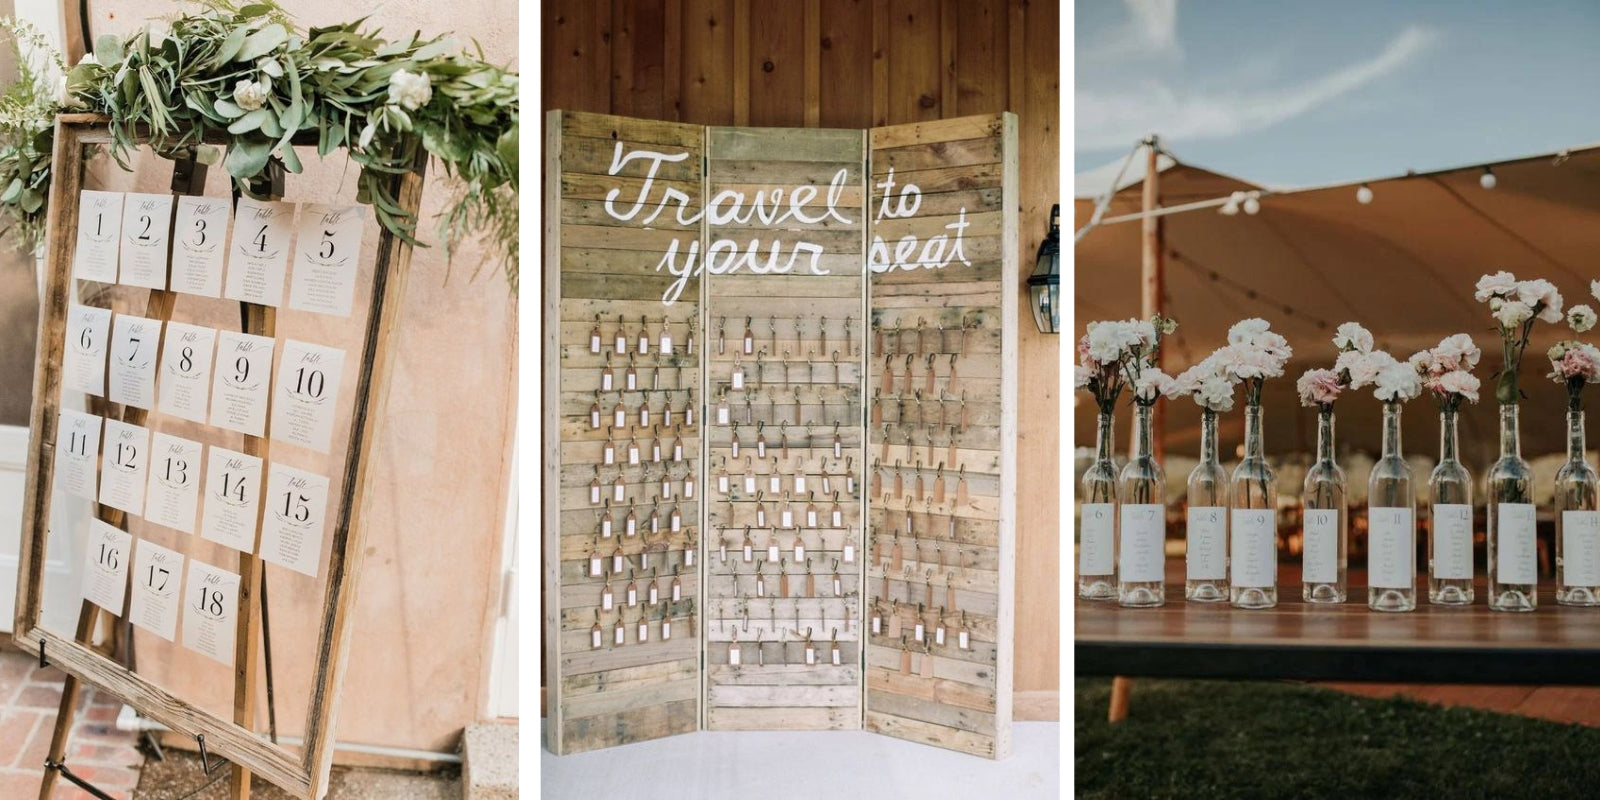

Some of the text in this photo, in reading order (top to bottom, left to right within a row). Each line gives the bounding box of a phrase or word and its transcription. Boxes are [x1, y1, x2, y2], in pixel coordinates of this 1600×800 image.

[604, 141, 922, 227] Travel to
[96, 213, 103, 237] 1
[138, 215, 151, 240] 2
[192, 219, 207, 247] 3
[252, 225, 268, 252] 4
[318, 230, 336, 259] 5
[656, 206, 972, 307] your seat
[80, 327, 92, 350] 6
[128, 338, 141, 362] 7
[179, 346, 194, 373] 8
[234, 356, 250, 383] 9
[295, 366, 325, 399] 10
[69, 432, 87, 457] 11
[115, 442, 137, 470] 12
[164, 457, 188, 485] 13
[221, 472, 246, 502] 14
[282, 491, 310, 523] 15
[1095, 510, 1103, 519] 6
[1148, 510, 1156, 521] 7
[1209, 511, 1218, 523] 8
[1256, 514, 1265, 526] 9
[1316, 514, 1328, 526] 10
[98, 543, 119, 570] 16
[148, 565, 170, 591] 17
[199, 587, 224, 617] 18
